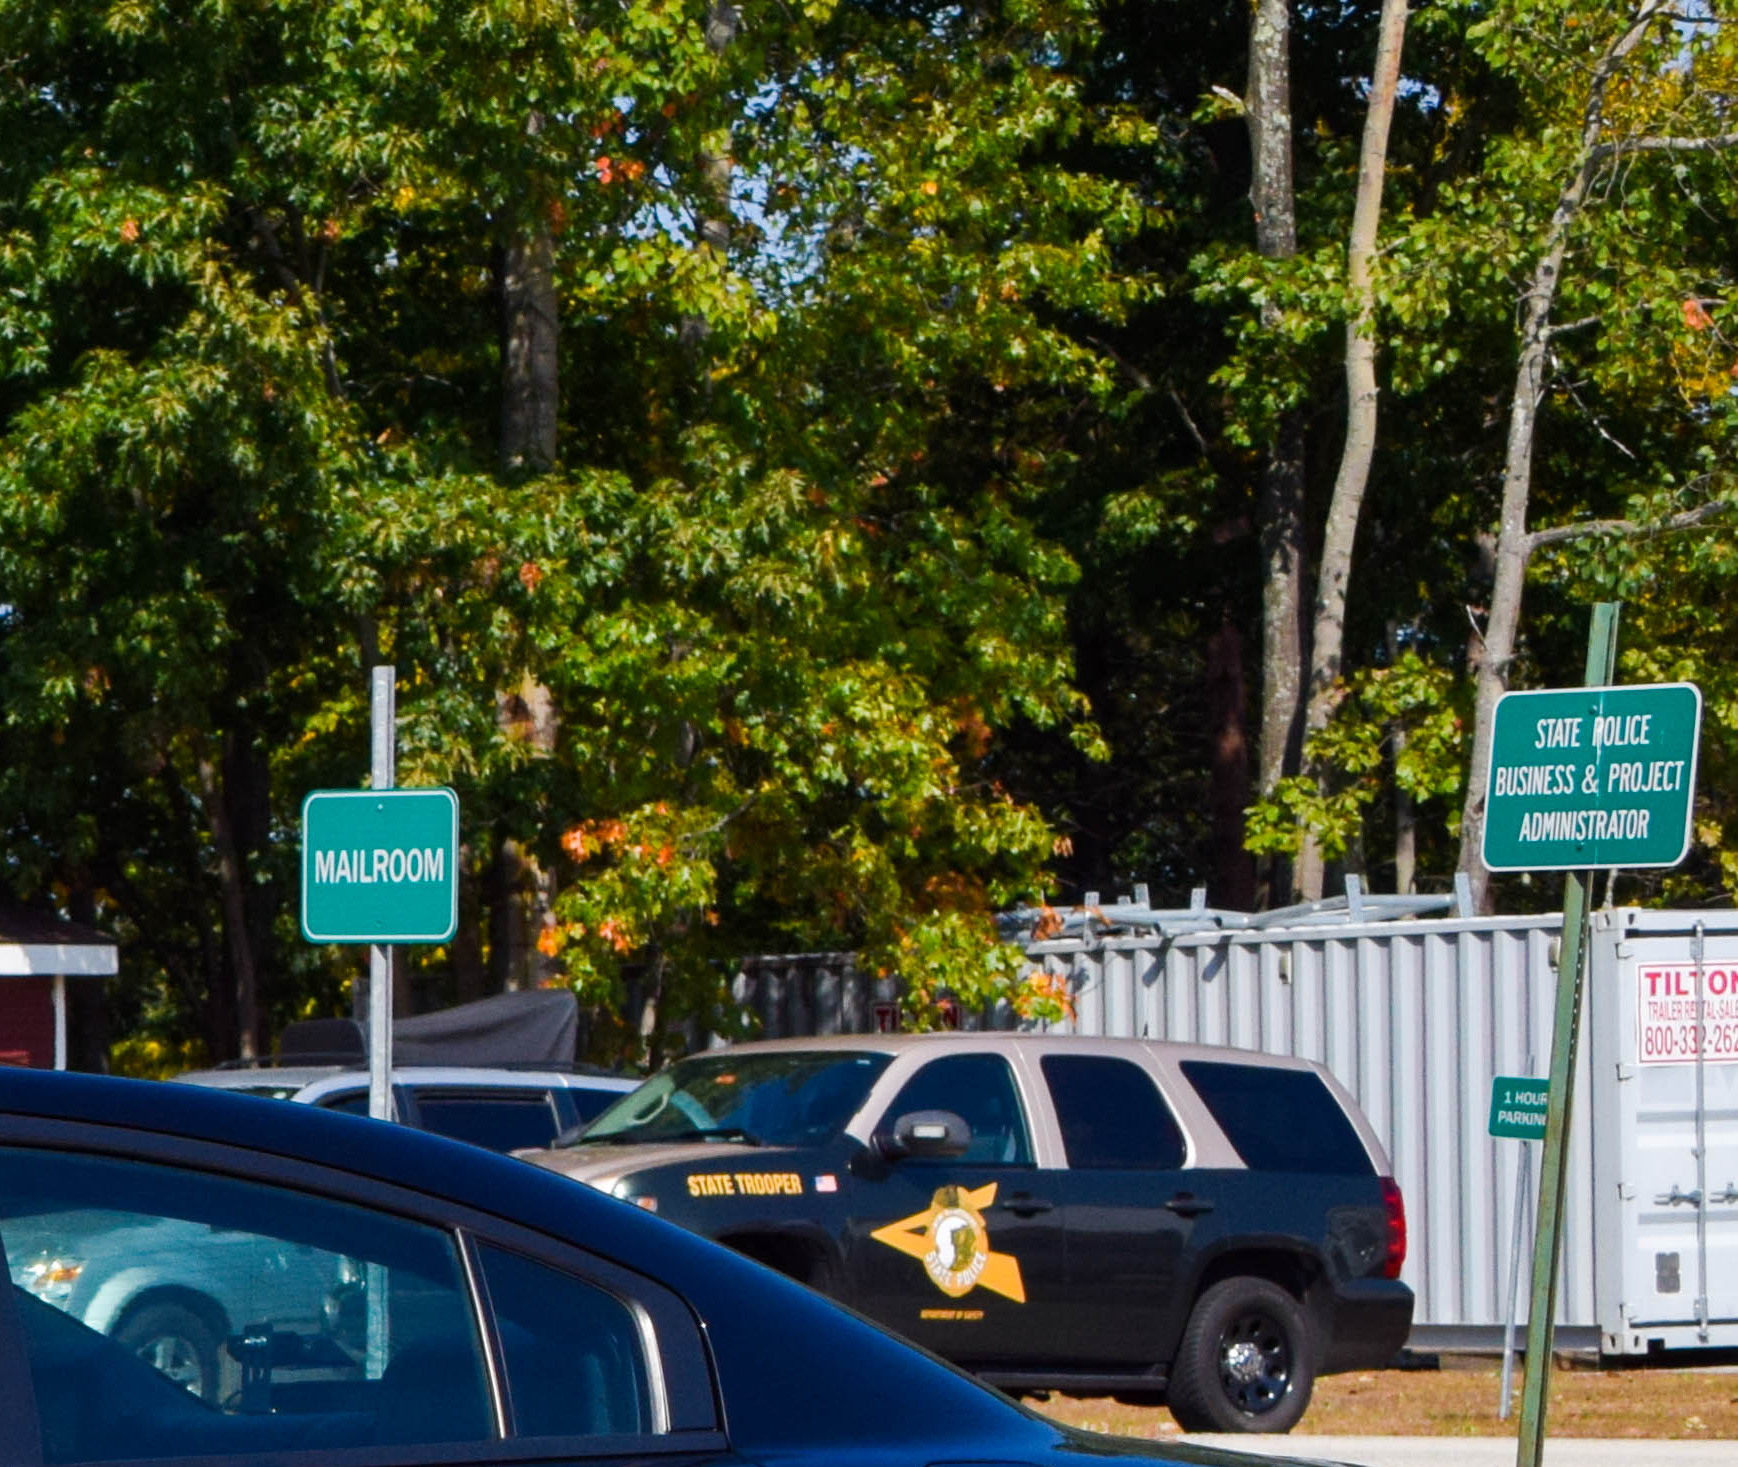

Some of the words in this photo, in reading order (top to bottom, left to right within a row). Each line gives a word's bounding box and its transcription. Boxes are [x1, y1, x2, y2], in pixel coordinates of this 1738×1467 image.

[1534, 717, 1583, 749] STATE
[1592, 714, 1653, 747] POLICE
[1494, 764, 1576, 797] BUSINESS
[1581, 764, 1600, 795] &
[1607, 760, 1685, 793] PROJECT
[1518, 809, 1650, 843] ADMINISTRATOR
[314, 847, 445, 885] MAILROOM
[1648, 1000, 1684, 1022] TRAILER
[1503, 1091, 1512, 1104] 1
[1514, 1090, 1548, 1107] HOUR
[687, 1174, 735, 1198] STATE
[734, 1172, 804, 1197] TROOPER
[923, 1249, 953, 1288] STATE
[956, 1249, 989, 1289] POLICE
